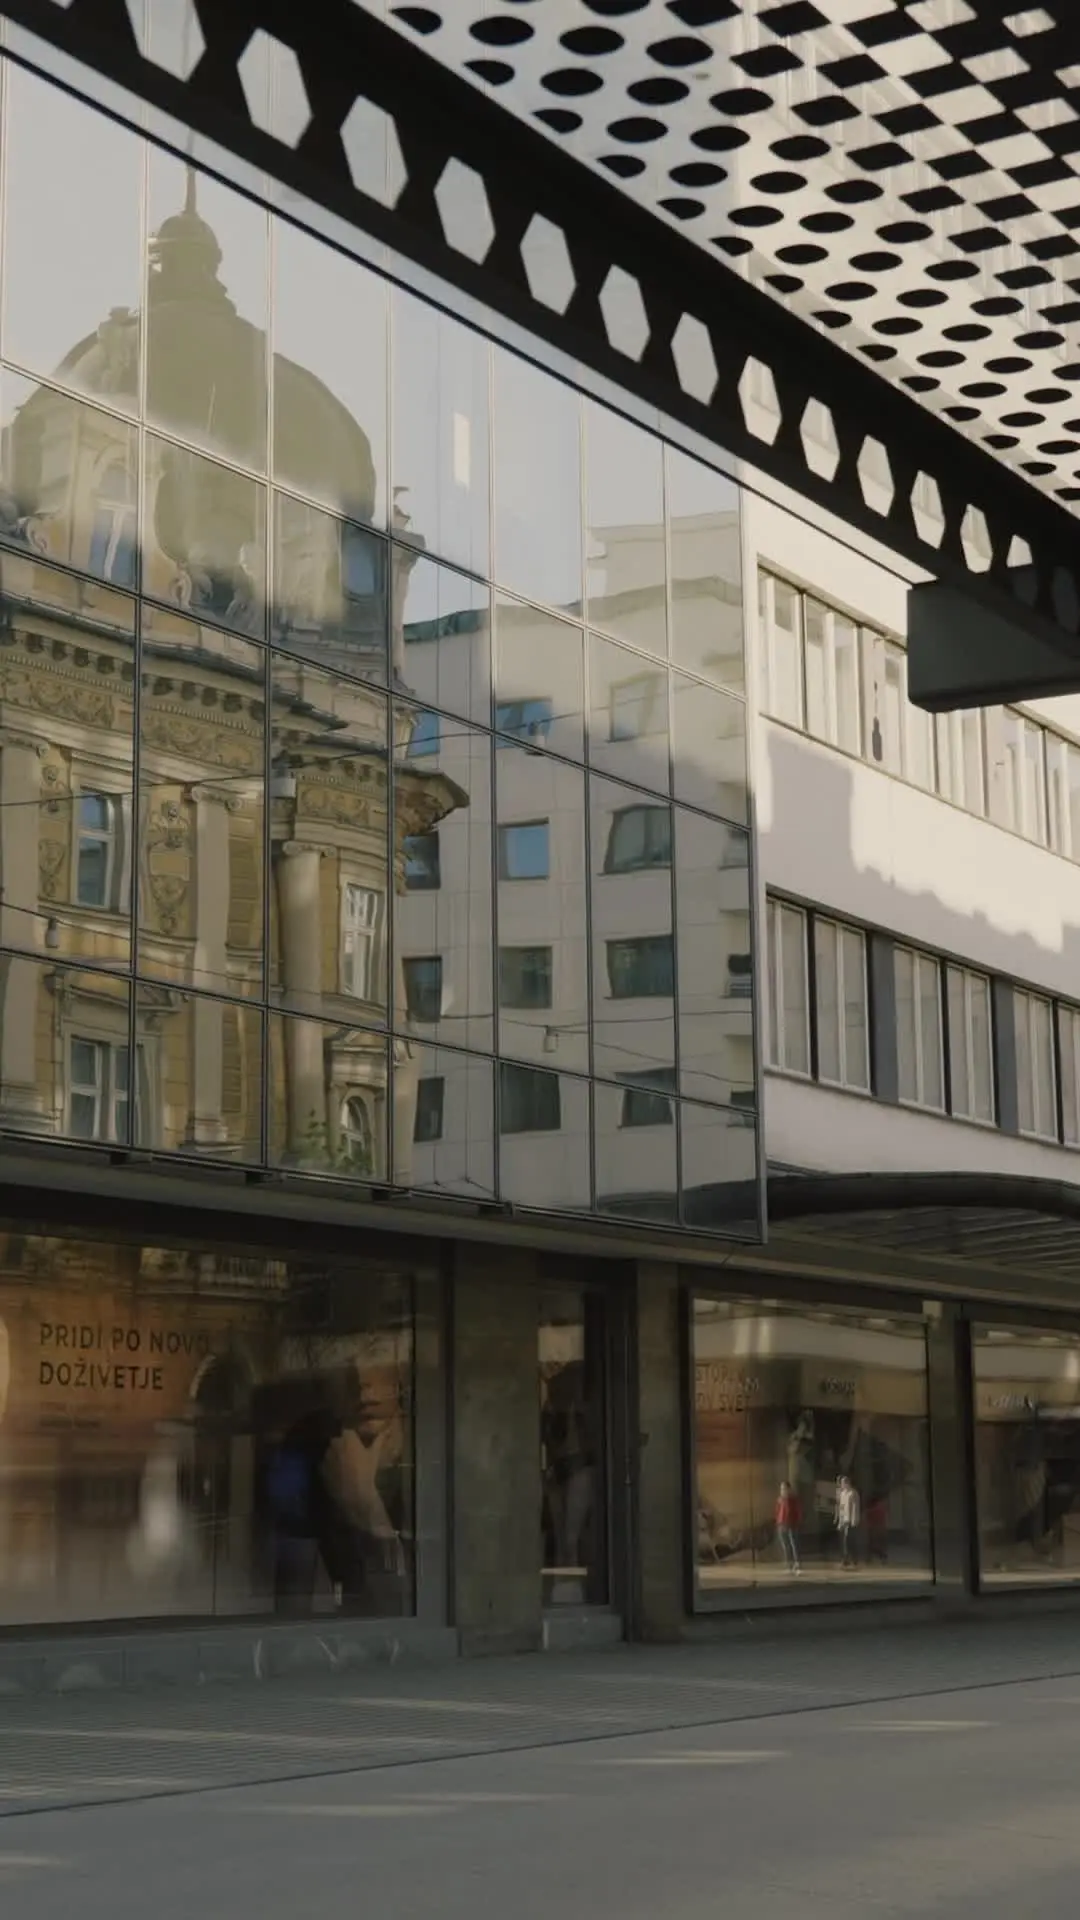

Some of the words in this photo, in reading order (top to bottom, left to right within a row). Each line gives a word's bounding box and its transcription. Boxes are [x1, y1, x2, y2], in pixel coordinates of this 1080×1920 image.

[39, 1322, 103, 1349] PRIDI
[111, 1326, 141, 1352] PO
[39, 1357, 164, 1391] DOŽIVETJE
